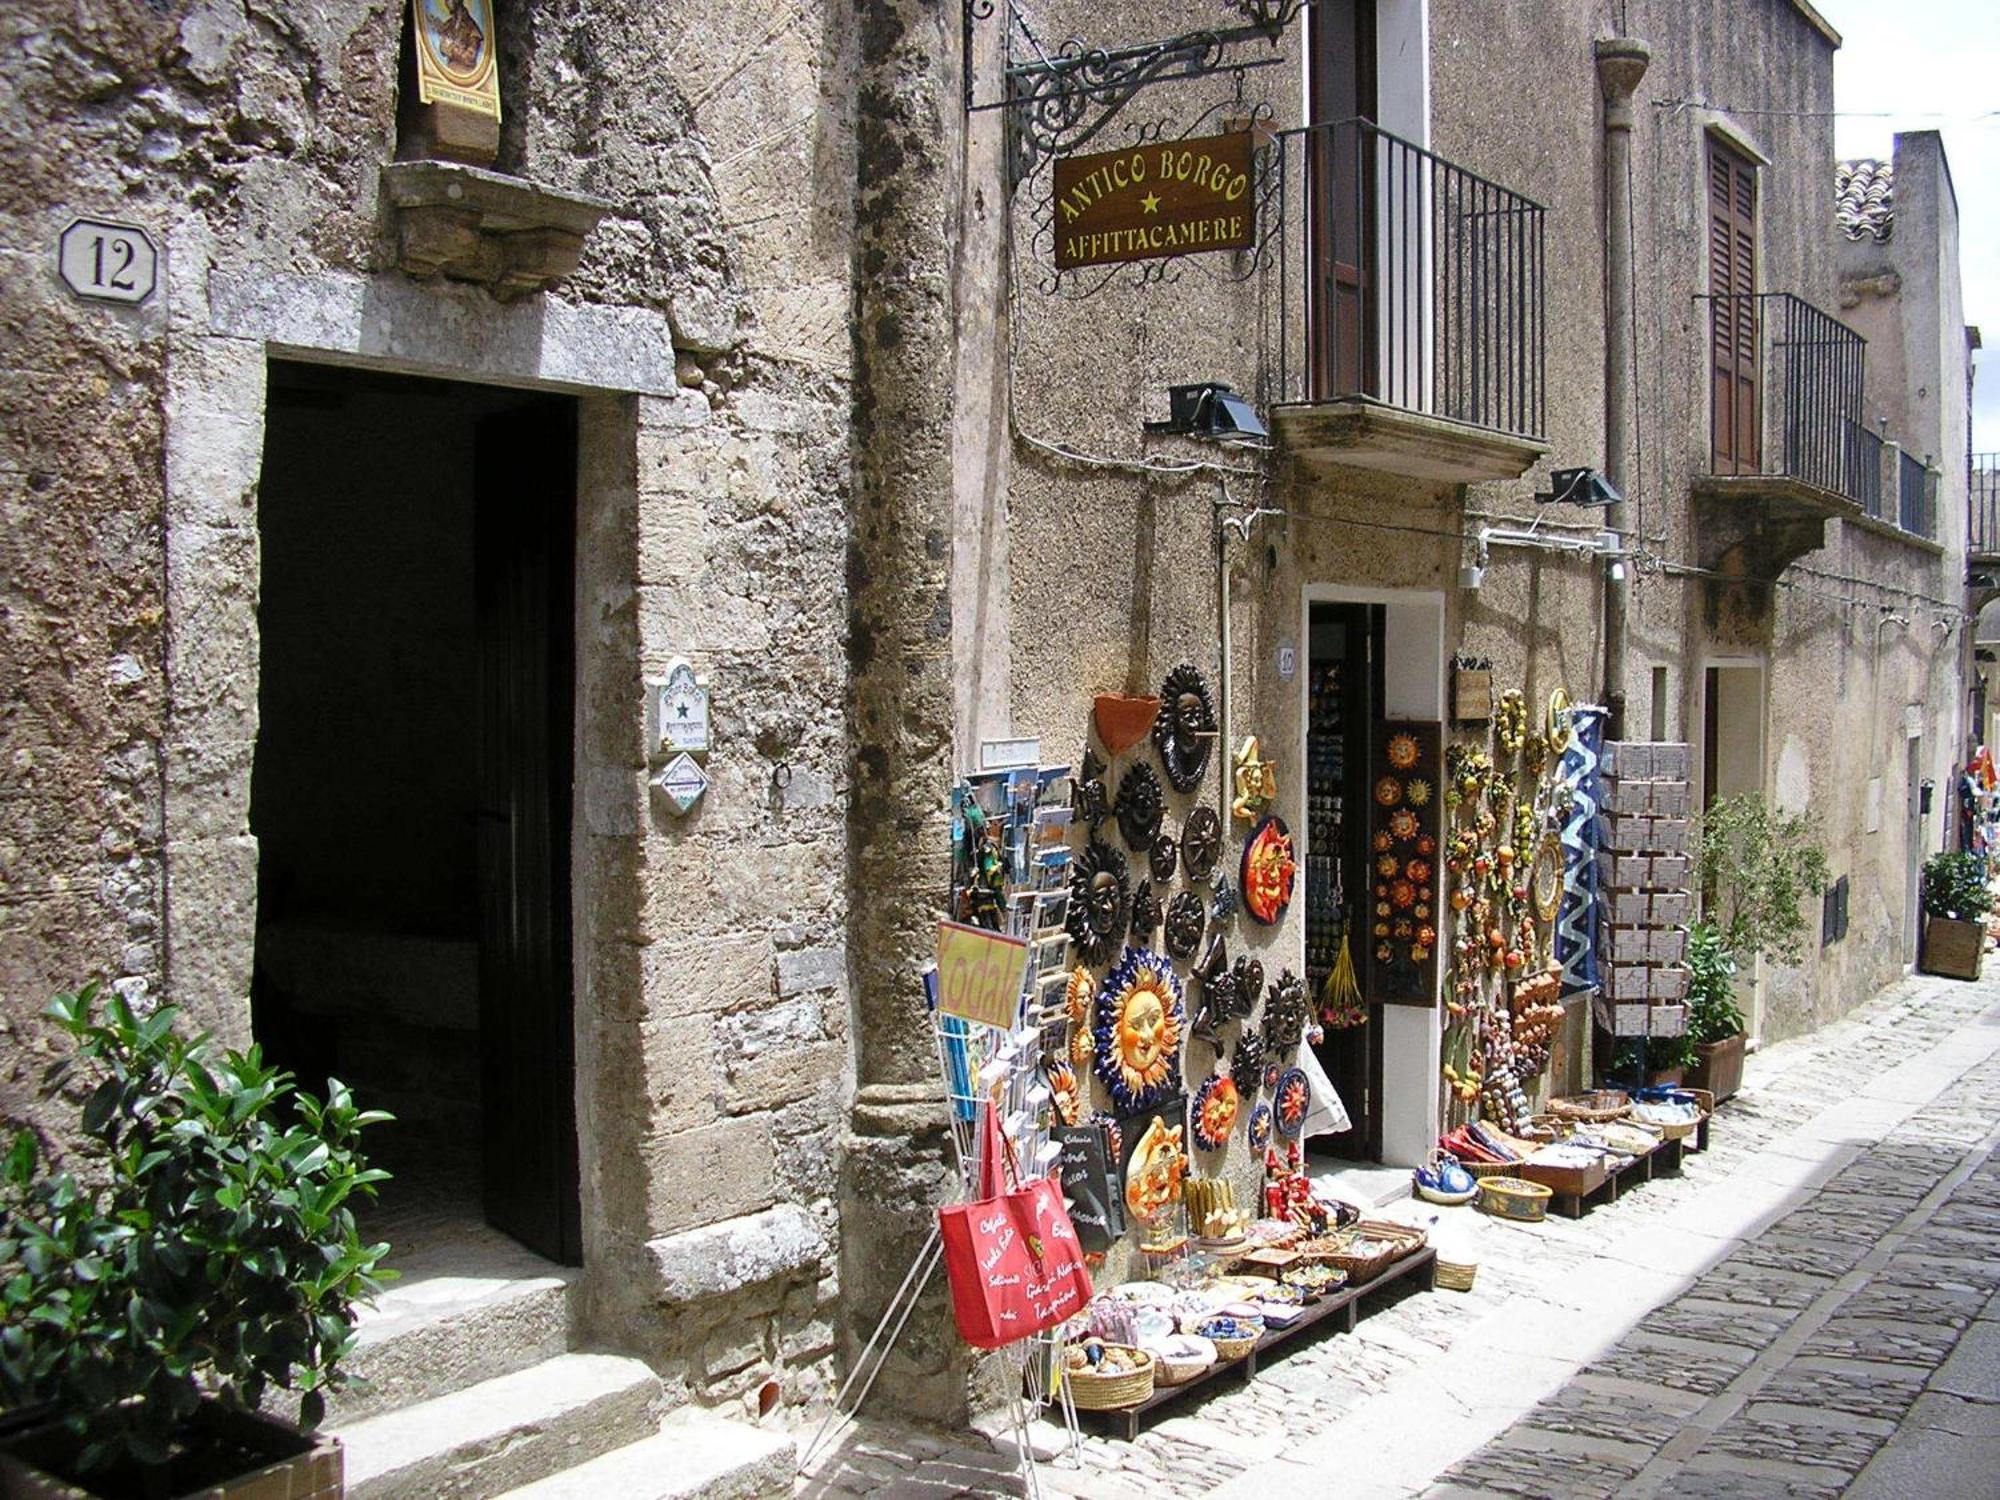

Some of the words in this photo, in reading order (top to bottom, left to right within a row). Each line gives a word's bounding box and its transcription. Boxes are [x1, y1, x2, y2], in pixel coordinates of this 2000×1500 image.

[1059, 153, 1146, 224] ANTICO
[1159, 149, 1247, 201] BORGO
[88, 236, 135, 291] 12
[1065, 215, 1243, 260] AFFITTACAMERE
